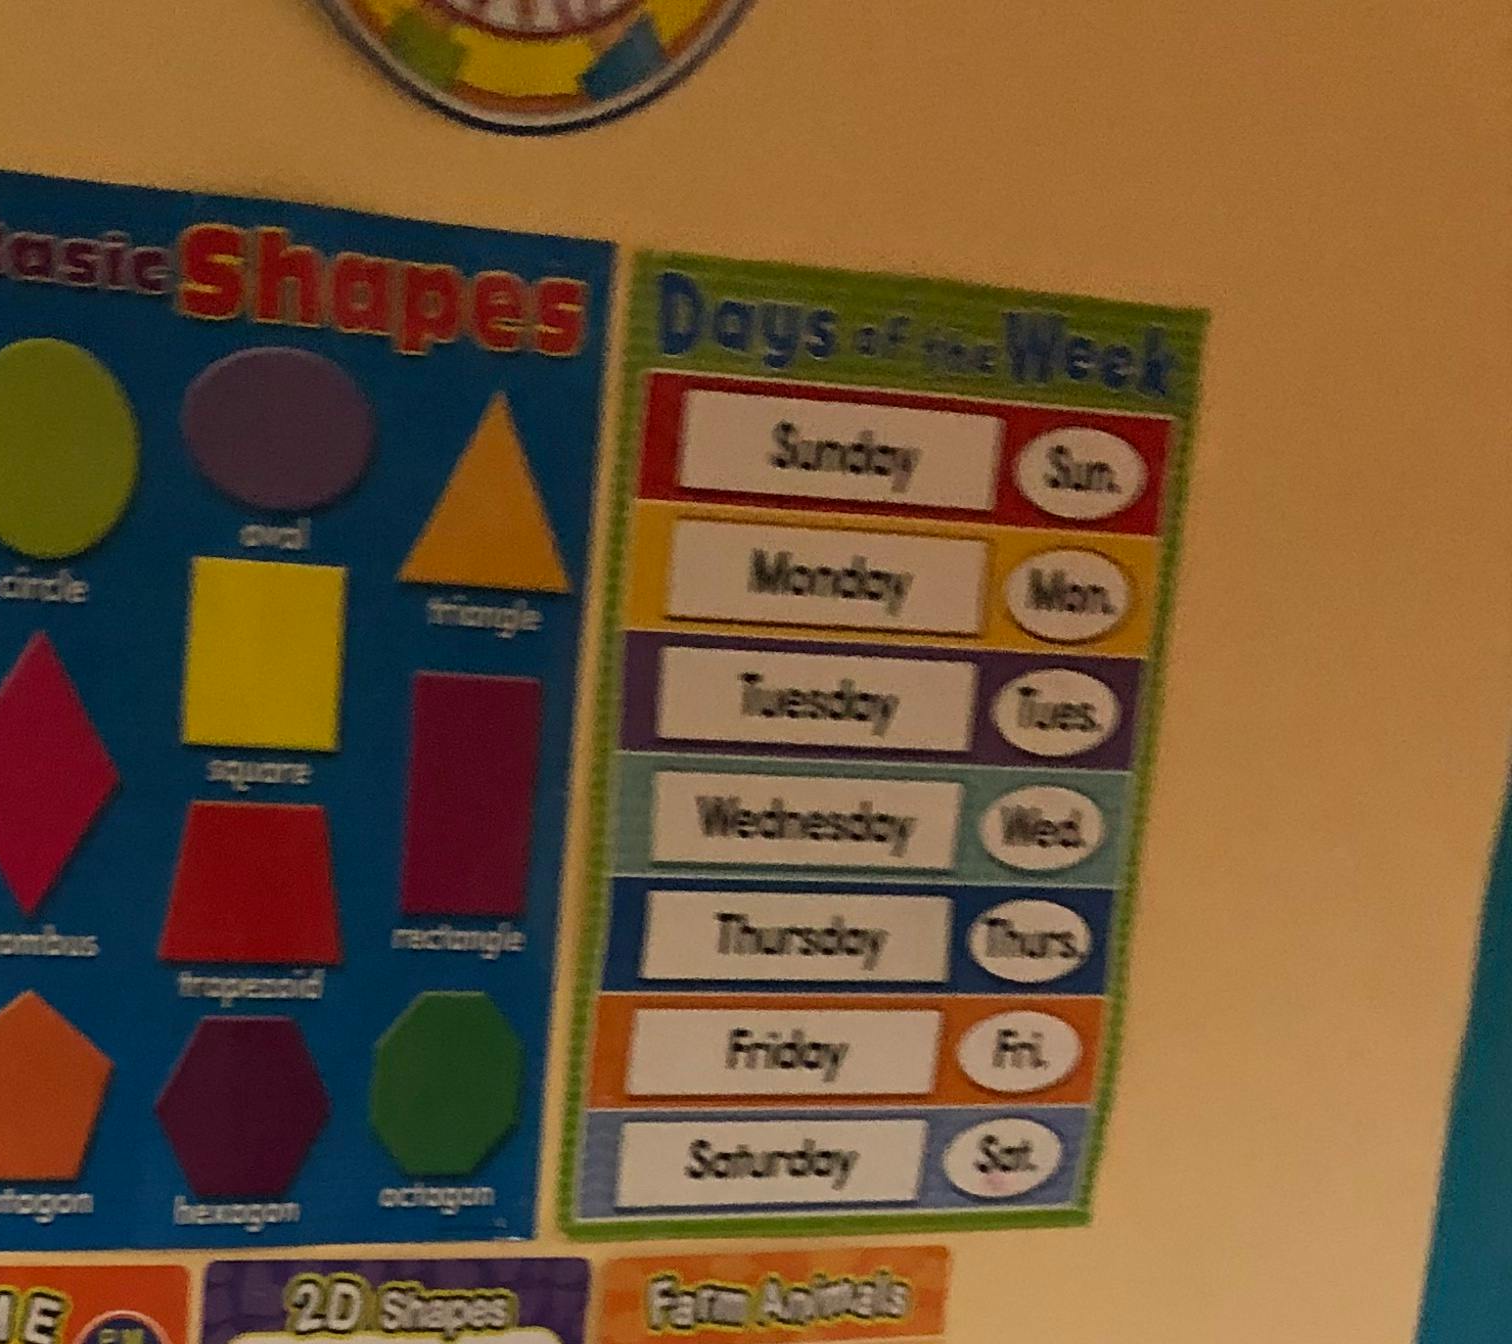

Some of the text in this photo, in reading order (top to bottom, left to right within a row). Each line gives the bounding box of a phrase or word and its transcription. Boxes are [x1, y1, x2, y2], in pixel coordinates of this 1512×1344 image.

[176, 222, 587, 356] Shapes
[658, 271, 1177, 396] Days of the Week
[769, 420, 922, 494] Sunday
[748, 547, 914, 617] Monday
[740, 672, 900, 736] Tuesday
[696, 795, 916, 857] Wednesday
[393, 922, 525, 959] rectangle
[715, 911, 889, 970] Thursday
[725, 1028, 849, 1082] Friday
[684, 1138, 860, 1189] Saturday
[291, 1279, 514, 1340] 2D Shapes
